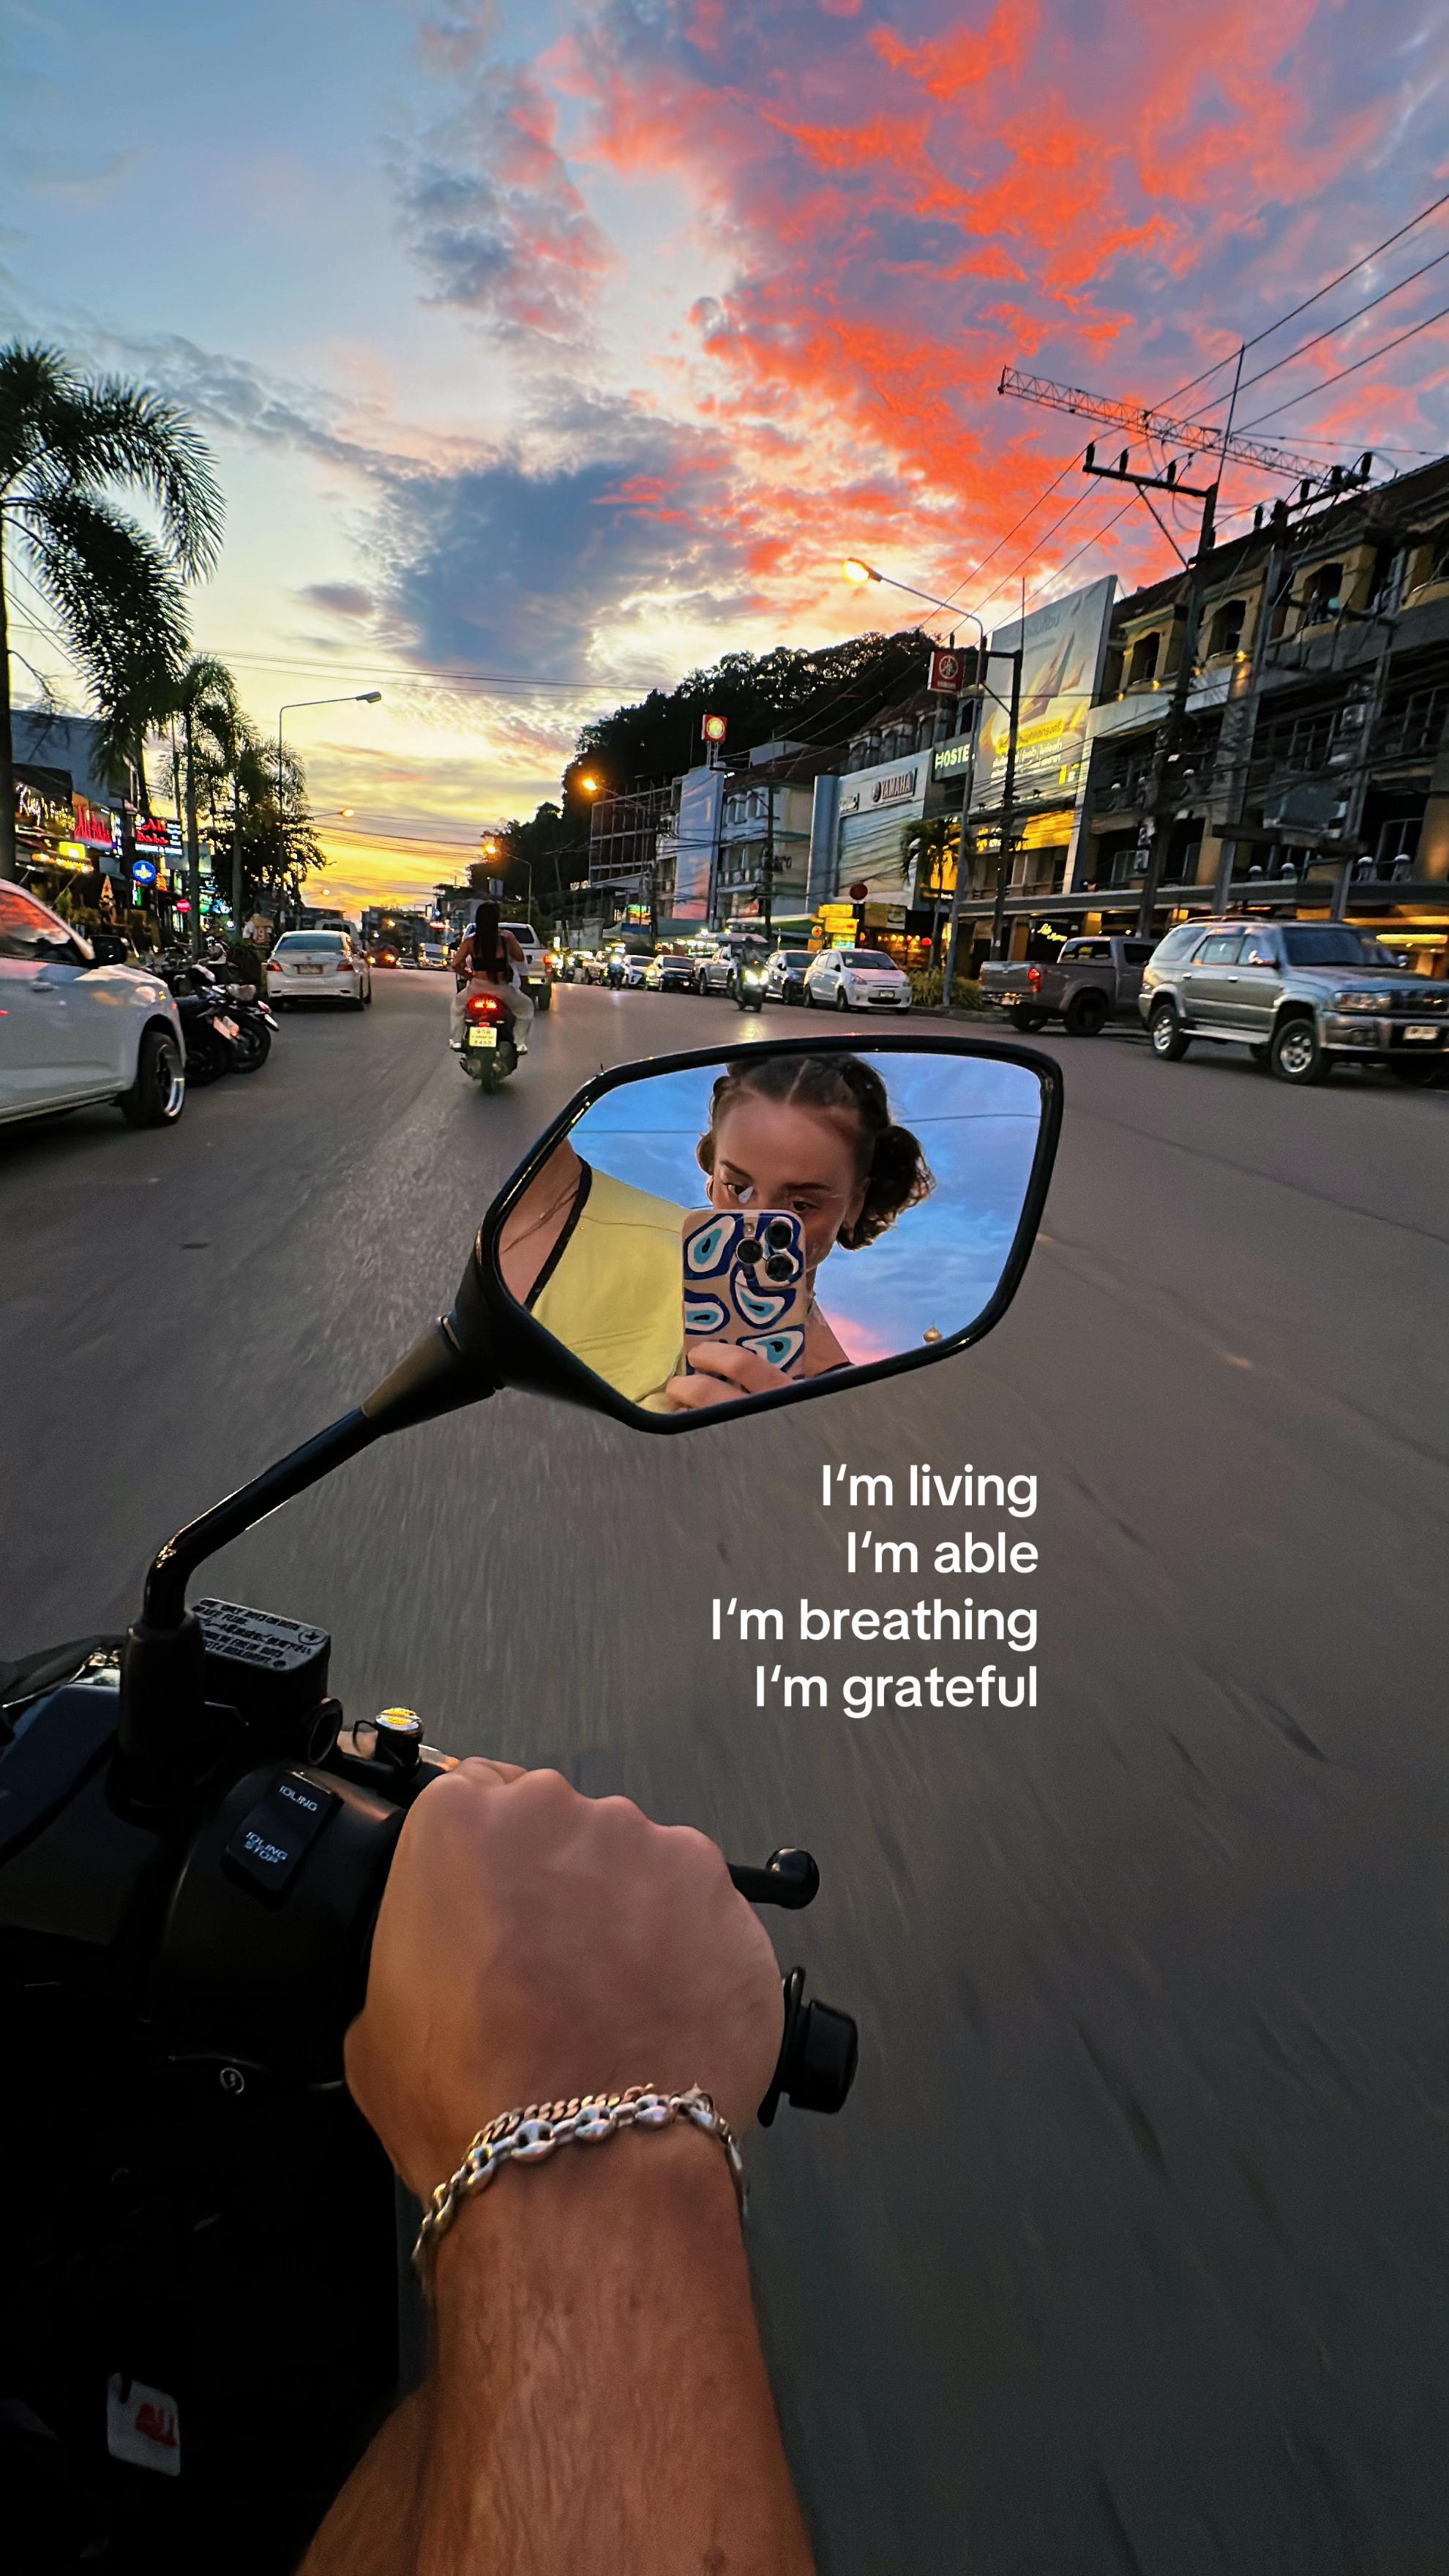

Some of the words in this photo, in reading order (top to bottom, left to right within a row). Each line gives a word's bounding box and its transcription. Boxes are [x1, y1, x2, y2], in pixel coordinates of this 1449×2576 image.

[935, 744, 976, 769] HOSTE
[881, 771, 914, 798] YAMAHA
[279, 1786, 318, 1811] IDLING
[244, 1841, 278, 1863] STOP
[246, 1832, 288, 1860] IDLING
